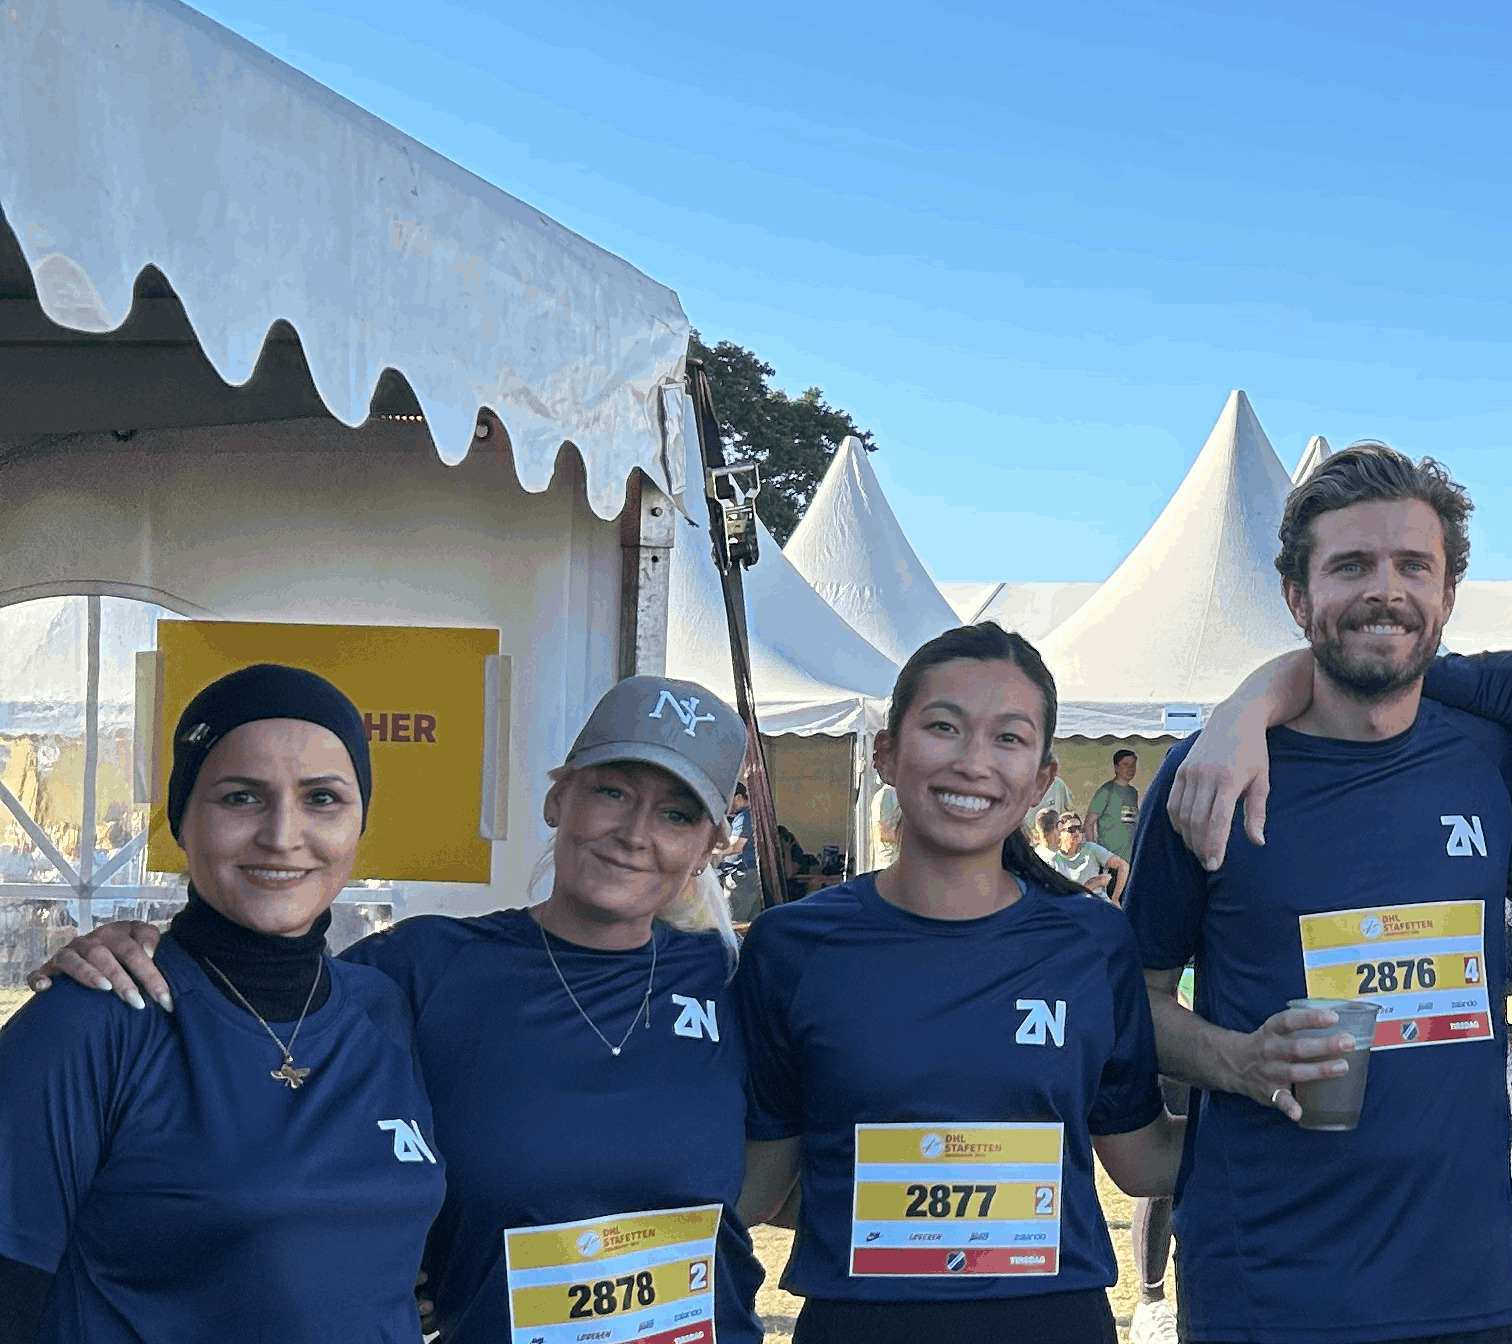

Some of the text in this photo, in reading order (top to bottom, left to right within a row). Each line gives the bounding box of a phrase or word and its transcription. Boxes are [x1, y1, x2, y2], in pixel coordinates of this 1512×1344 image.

[649, 690, 715, 737] NY
[1382, 914, 1400, 923] DHL
[1384, 920, 1433, 931] STAFETTEN
[1356, 958, 1436, 994] 2876
[1465, 958, 1479, 982] 4
[945, 1134, 965, 1143] DHL
[945, 1143, 1001, 1152] STAFETTEN
[905, 1184, 997, 1217] 2877
[1036, 1188, 1053, 1214] 2
[603, 1229, 656, 1247] STAFETTEN
[690, 1262, 707, 1290] 2
[567, 1271, 656, 1319] 2878
